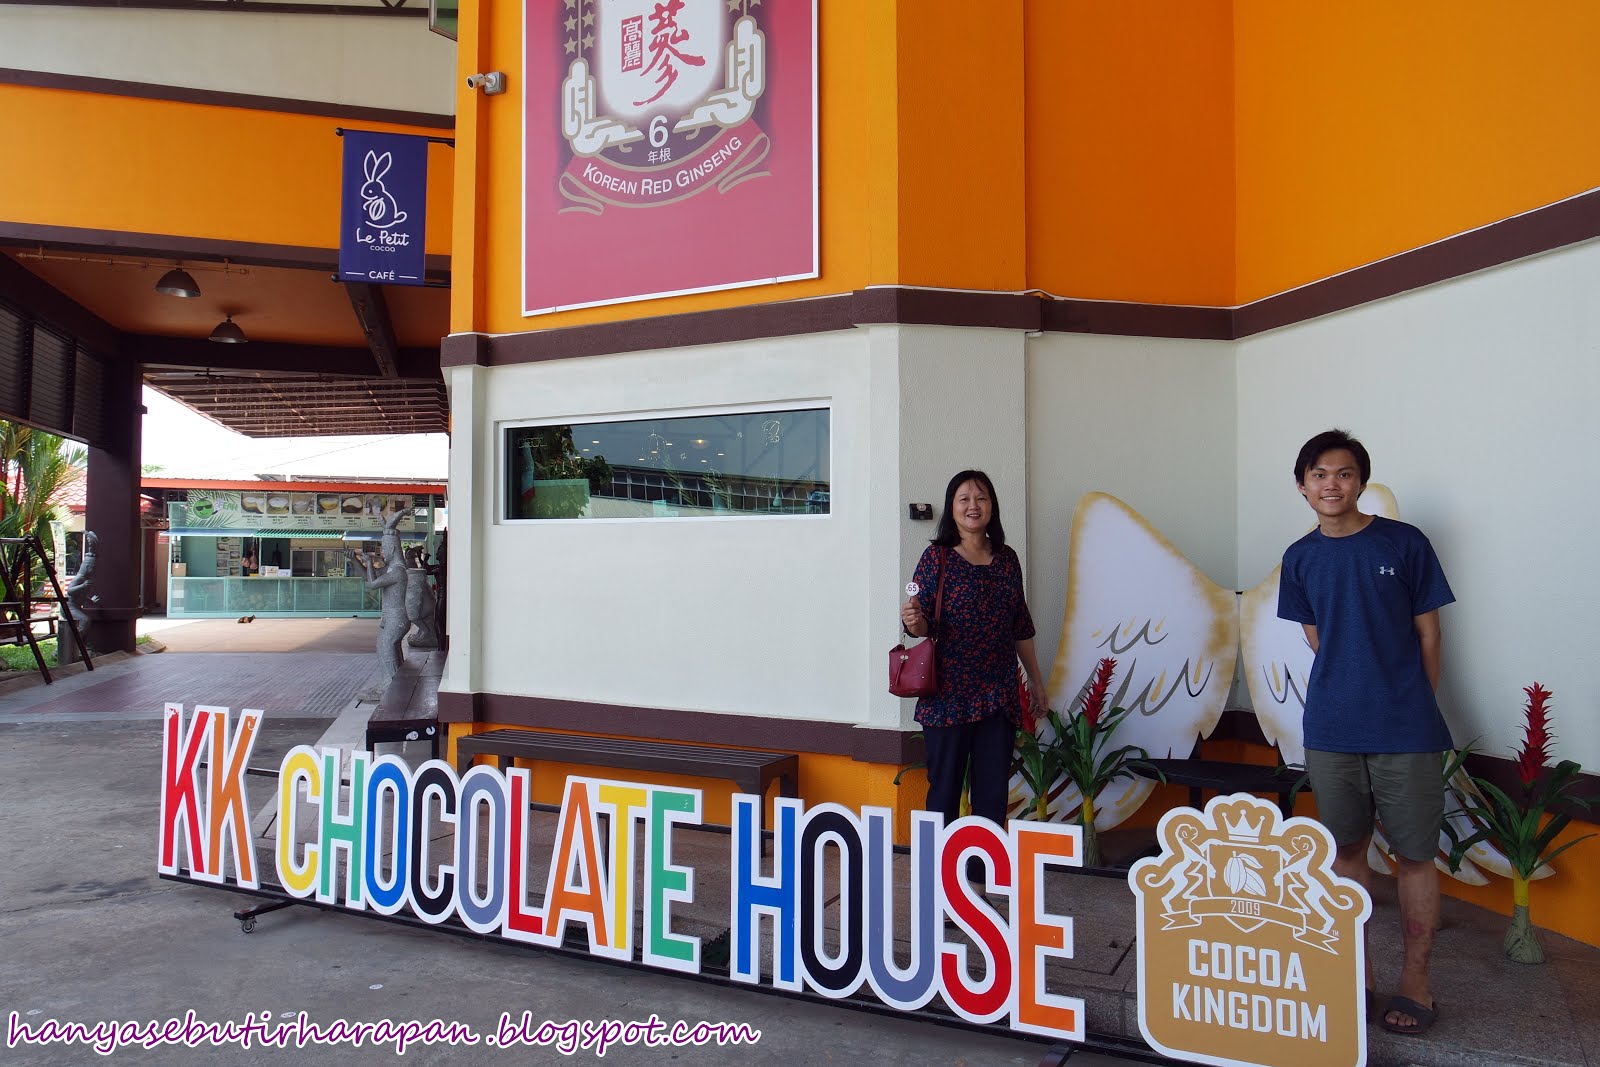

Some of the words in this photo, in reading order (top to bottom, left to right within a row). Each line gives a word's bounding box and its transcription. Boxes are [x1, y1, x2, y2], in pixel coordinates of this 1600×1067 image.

[622, 19, 642, 71] 高麗
[649, 115, 669, 148] 6
[583, 162, 638, 195] KOREAN
[640, 178, 673, 195] RED
[675, 136, 743, 188] GINSENG
[647, 147, 672, 164] 年根
[356, 227, 376, 243] Le
[379, 230, 410, 246] Petit
[368, 270, 395, 280] CAFÉ
[159, 702, 265, 889] KK
[277, 745, 702, 974] CHOCOLATE
[730, 793, 1085, 1041] HOUSE
[1230, 899, 1261, 916] 2009
[1188, 938, 1307, 992] COCOA
[1172, 982, 1327, 1043] KINGDOM
